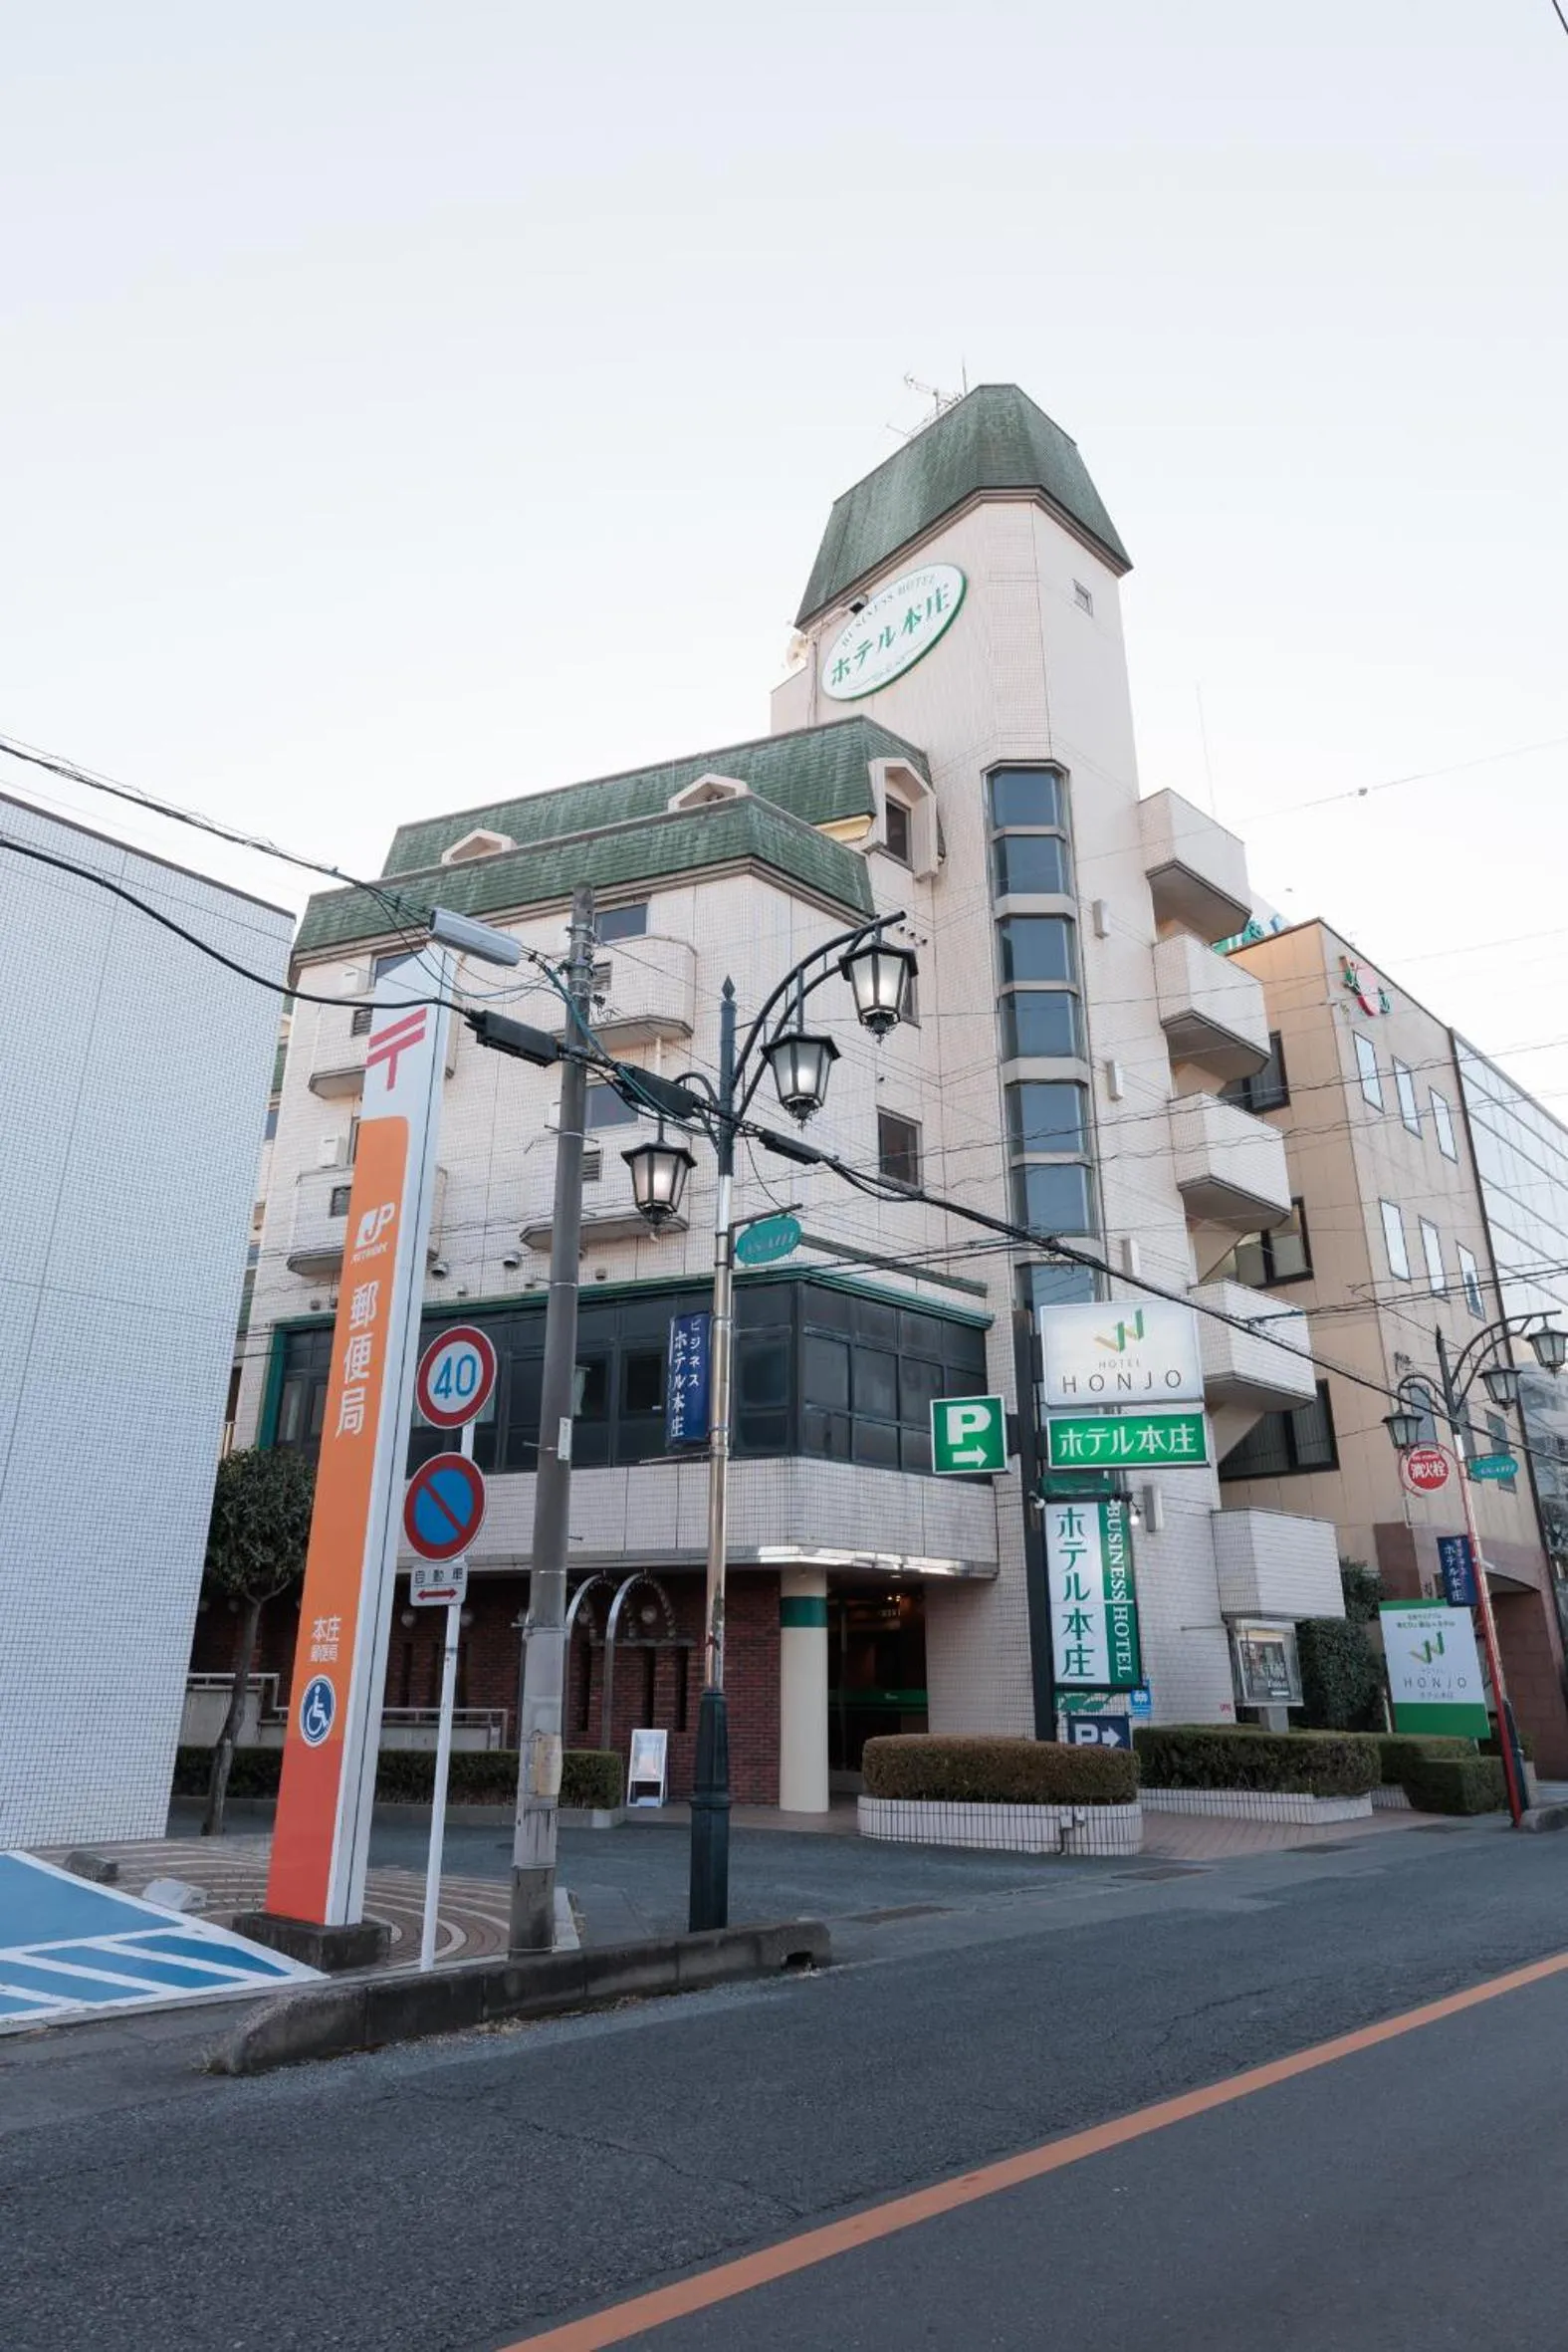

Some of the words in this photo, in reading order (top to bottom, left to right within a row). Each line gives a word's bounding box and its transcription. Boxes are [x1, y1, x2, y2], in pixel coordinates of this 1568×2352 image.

[831, 587, 951, 686] ホテル本庄
[335, 1280, 380, 1438] 郵便局
[688, 1317, 702, 1388] ビジネス
[1098, 1358, 1142, 1369] HOTEL
[433, 1353, 478, 1399] 40
[670, 1330, 689, 1438] ホテル本庄
[1062, 1369, 1183, 1394] HONJO
[946, 1404, 992, 1445] P
[1058, 1423, 1199, 1458] ホテル本庄
[1410, 1461, 1448, 1480] 消火栓
[1105, 1504, 1128, 1602] BUSINESS
[414, 1567, 464, 1584] 自動車
[1055, 1506, 1096, 1678] ホテル本庄
[313, 1614, 341, 1642] 本庄
[1112, 1605, 1133, 1678] HOTEL
[1404, 1677, 1467, 1690] HONJO
[1074, 1723, 1098, 1747] P
